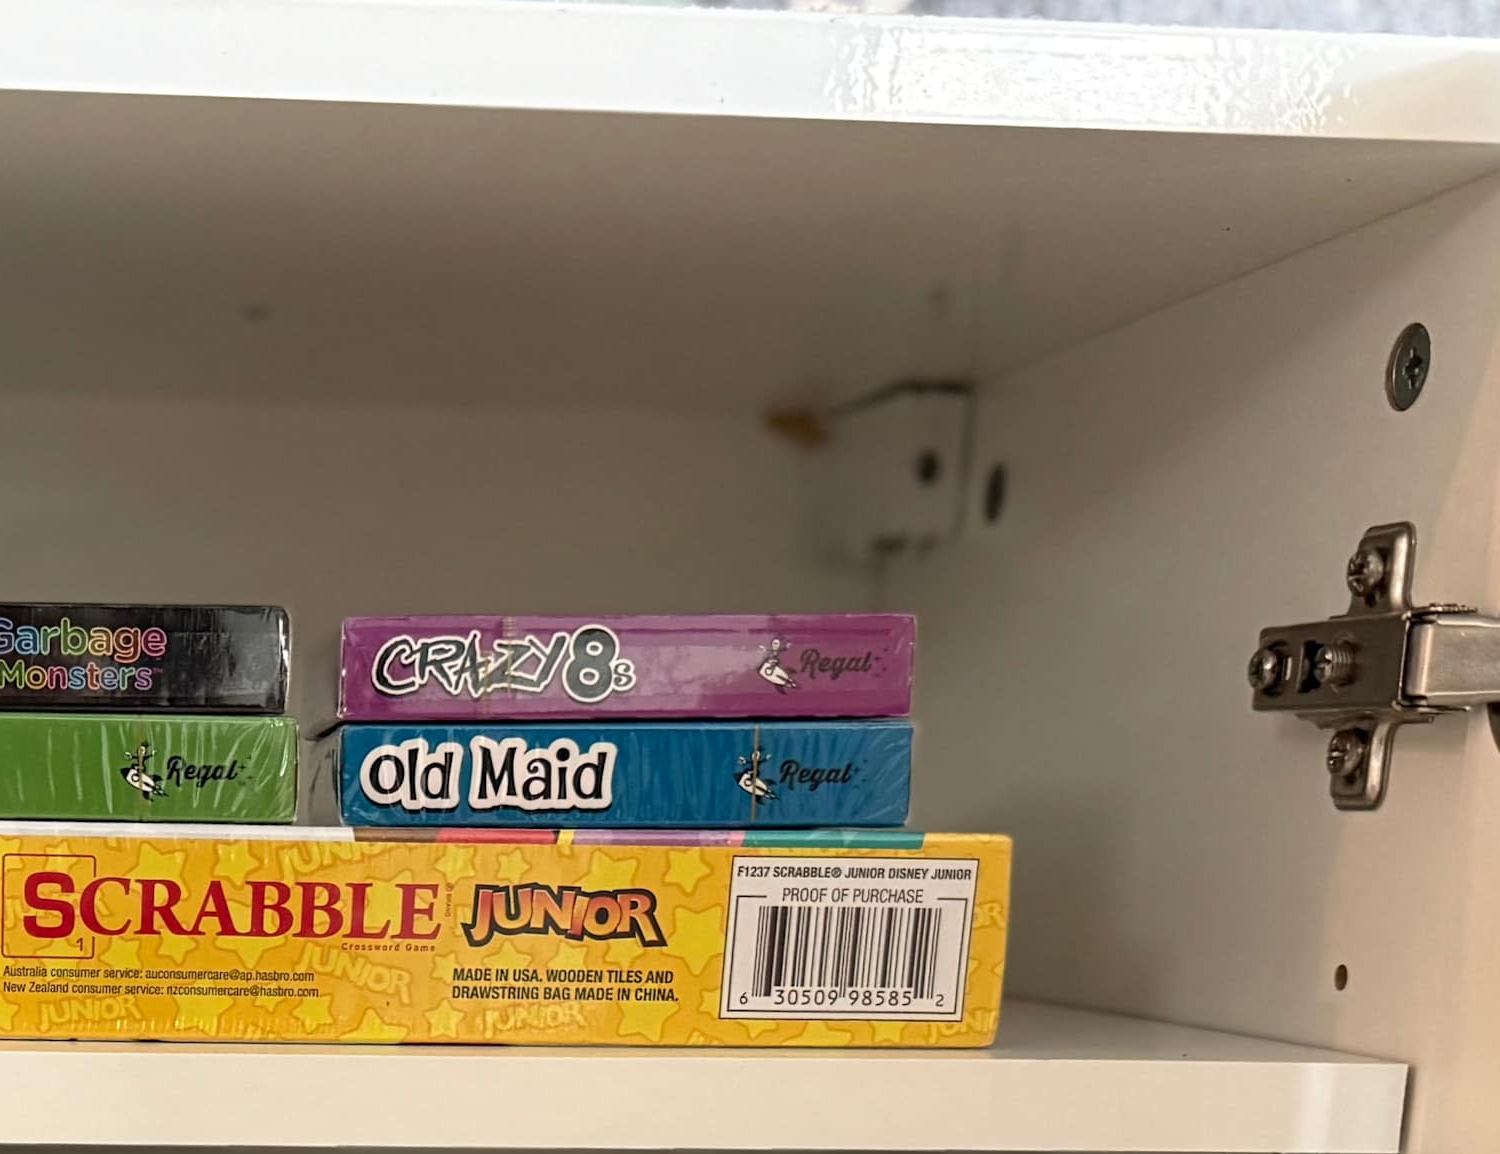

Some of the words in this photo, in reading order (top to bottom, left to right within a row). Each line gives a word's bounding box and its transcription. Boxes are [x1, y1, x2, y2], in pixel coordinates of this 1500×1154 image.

[799, 646, 871, 676] Regal
[166, 753, 238, 788] Regal
[360, 738, 464, 810] Old
[468, 735, 618, 810] Maid
[778, 759, 853, 785] Regal
[737, 865, 770, 878] F1237
[844, 867, 886, 880] JUNIOR
[888, 867, 929, 880] DISNEY
[930, 868, 972, 881] JUNIOR
[782, 888, 828, 903] PROOF
[831, 888, 849, 903] OF
[852, 888, 924, 904] PURCHASE
[22, 871, 442, 941] SCRABBLE
[459, 881, 668, 948] JUNIOR
[341, 942, 400, 952] Crossword
[405, 943, 436, 953] Game
[2, 965, 48, 978] Australia
[50, 967, 100, 979] consumer
[103, 967, 143, 980] service:
[144, 969, 315, 983] auconsumercare@ap.hasbro.com
[452, 967, 491, 982] MADE
[495, 968, 509, 982] IN
[512, 968, 543, 983] USA.
[546, 968, 603, 983] WOODEN
[607, 969, 642, 984] TILES
[645, 970, 674, 984] AND
[2, 981, 26, 993] New
[29, 981, 69, 994] Zealand
[71, 984, 123, 995] consumer
[124, 983, 164, 996] service:
[166, 984, 319, 998] nzconsumercare@hasbro.com
[451, 985, 539, 1000] DRAWSTRING
[543, 986, 571, 1001] BAG
[574, 986, 614, 1001] MADE
[617, 987, 630, 1001] IN
[634, 988, 679, 1003] CHINA.
[739, 992, 748, 1005] 6
[774, 989, 839, 1006] 30509
[849, 990, 913, 1007] 98585
[935, 993, 945, 1008] 2
